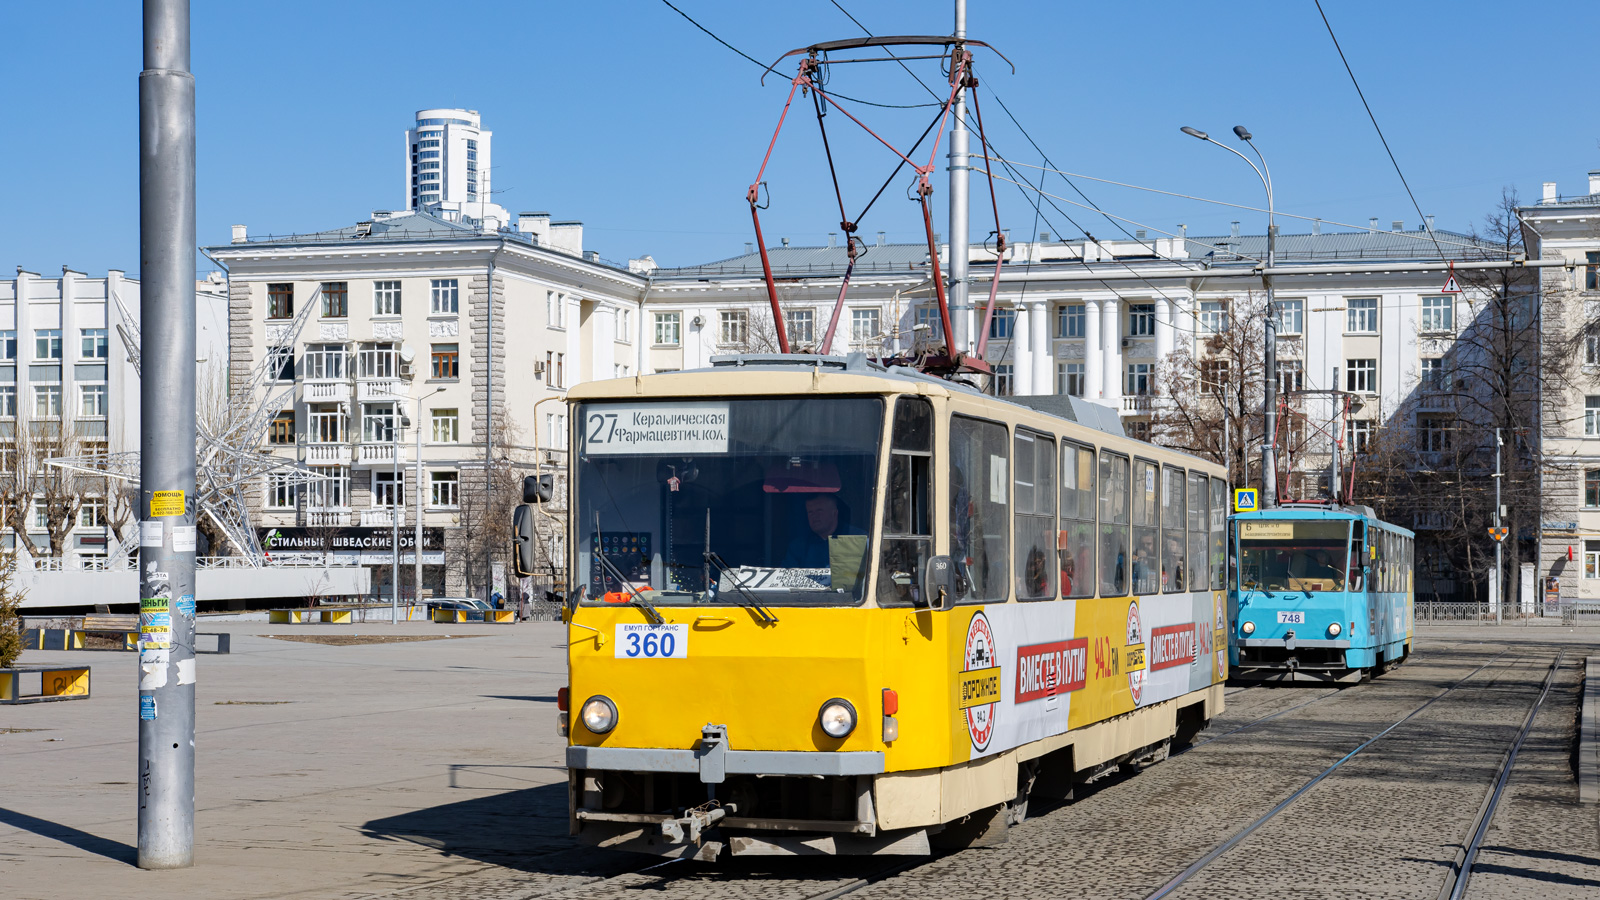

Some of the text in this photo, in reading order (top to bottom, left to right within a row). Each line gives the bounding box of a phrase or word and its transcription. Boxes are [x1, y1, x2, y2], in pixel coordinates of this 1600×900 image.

[587, 413, 618, 444] 27
[632, 411, 726, 428] Керамическая
[1246, 522, 1252, 531] 6
[269, 537, 431, 548] СТИЛЬНЫЕ ШВЕДСКИЕ ОБИ
[935, 561, 947, 571] 360
[736, 568, 776, 589] 27
[141, 599, 168, 608] ДЕНЬГИ
[1282, 614, 1301, 623] 748
[625, 632, 675, 658] 360
[1152, 633, 1175, 665] ВМЕСТЕ
[1095, 636, 1111, 680] 94.2
[1020, 647, 1086, 694] ВМЕСТЕ В ПУТИ!
[963, 676, 998, 701] ДОРОЖНОЕ
